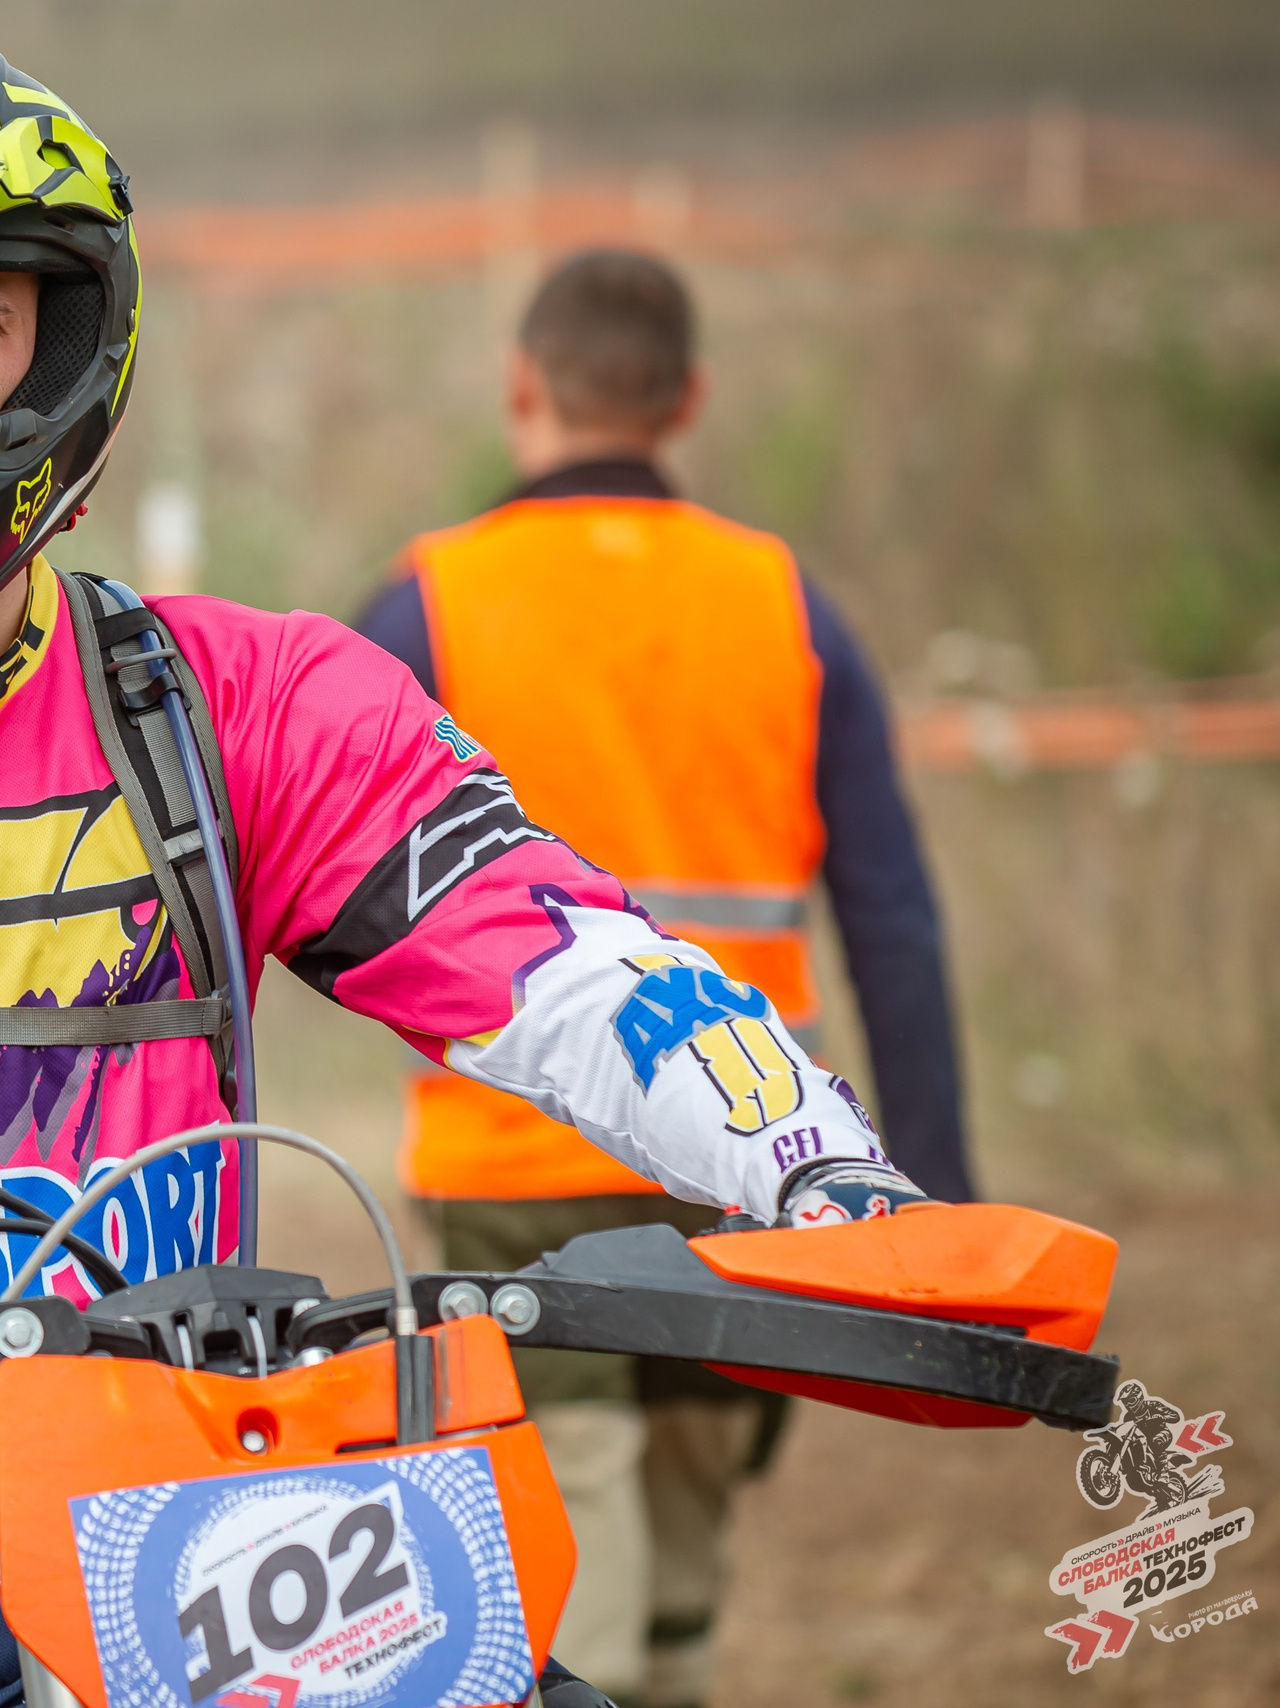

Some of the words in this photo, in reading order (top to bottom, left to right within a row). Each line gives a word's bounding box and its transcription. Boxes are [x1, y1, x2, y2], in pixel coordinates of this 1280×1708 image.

[178, 1503, 410, 1704] 102
[291, 1601, 404, 1670] СЛОБОДСКАЯ
[319, 1636, 376, 1674] БАЛКА
[379, 1613, 418, 1643] 2025
[344, 1619, 443, 1680] ТЕХНОФЕСТ
